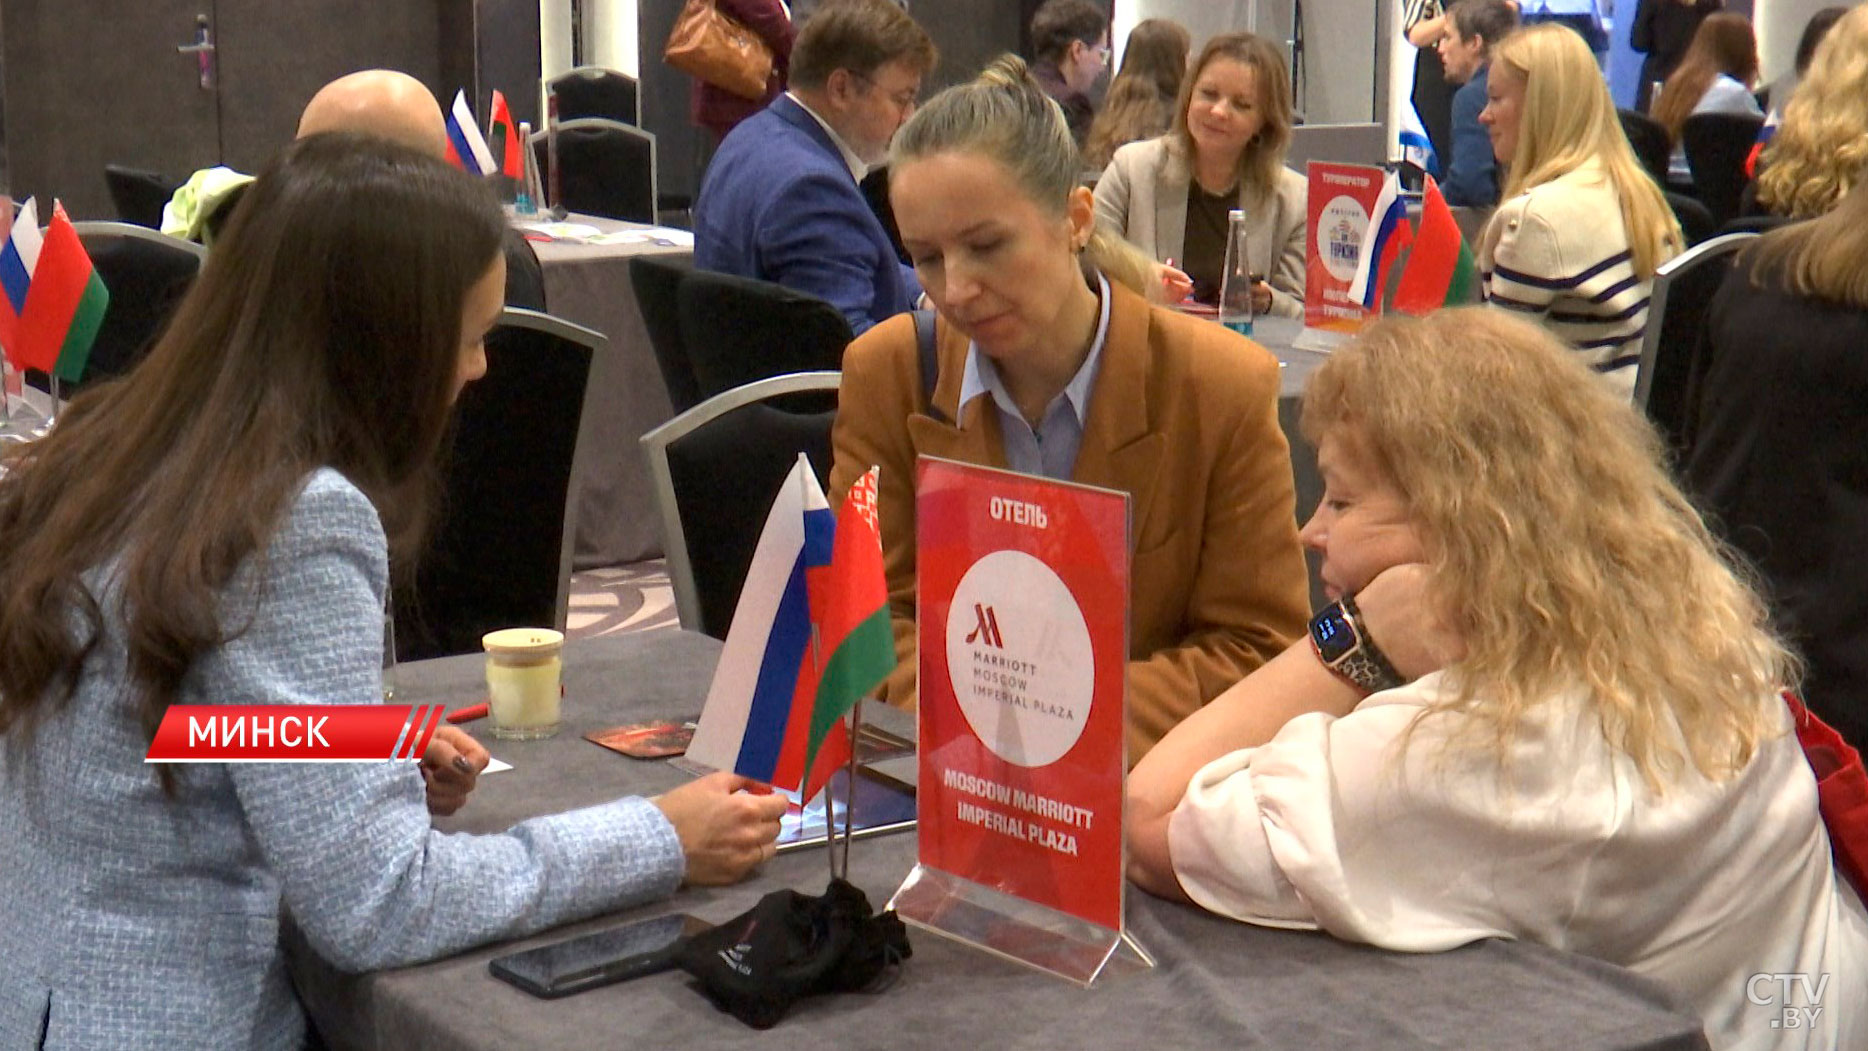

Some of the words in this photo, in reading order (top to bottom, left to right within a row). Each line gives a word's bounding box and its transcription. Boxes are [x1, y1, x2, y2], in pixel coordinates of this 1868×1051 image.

[990, 496, 1048, 529] ОТЕЛЬ
[973, 651, 1037, 676] MARRIOTT
[973, 667, 1027, 691] MOSCOW
[973, 685, 1028, 709] IMPERIAL
[1034, 700, 1075, 720] PLAZA
[944, 769, 1011, 805] MOSCOW
[1013, 787, 1094, 830] MARRIOTT
[957, 801, 1026, 840] IMPERIAL
[1028, 823, 1078, 857] PLAZA
